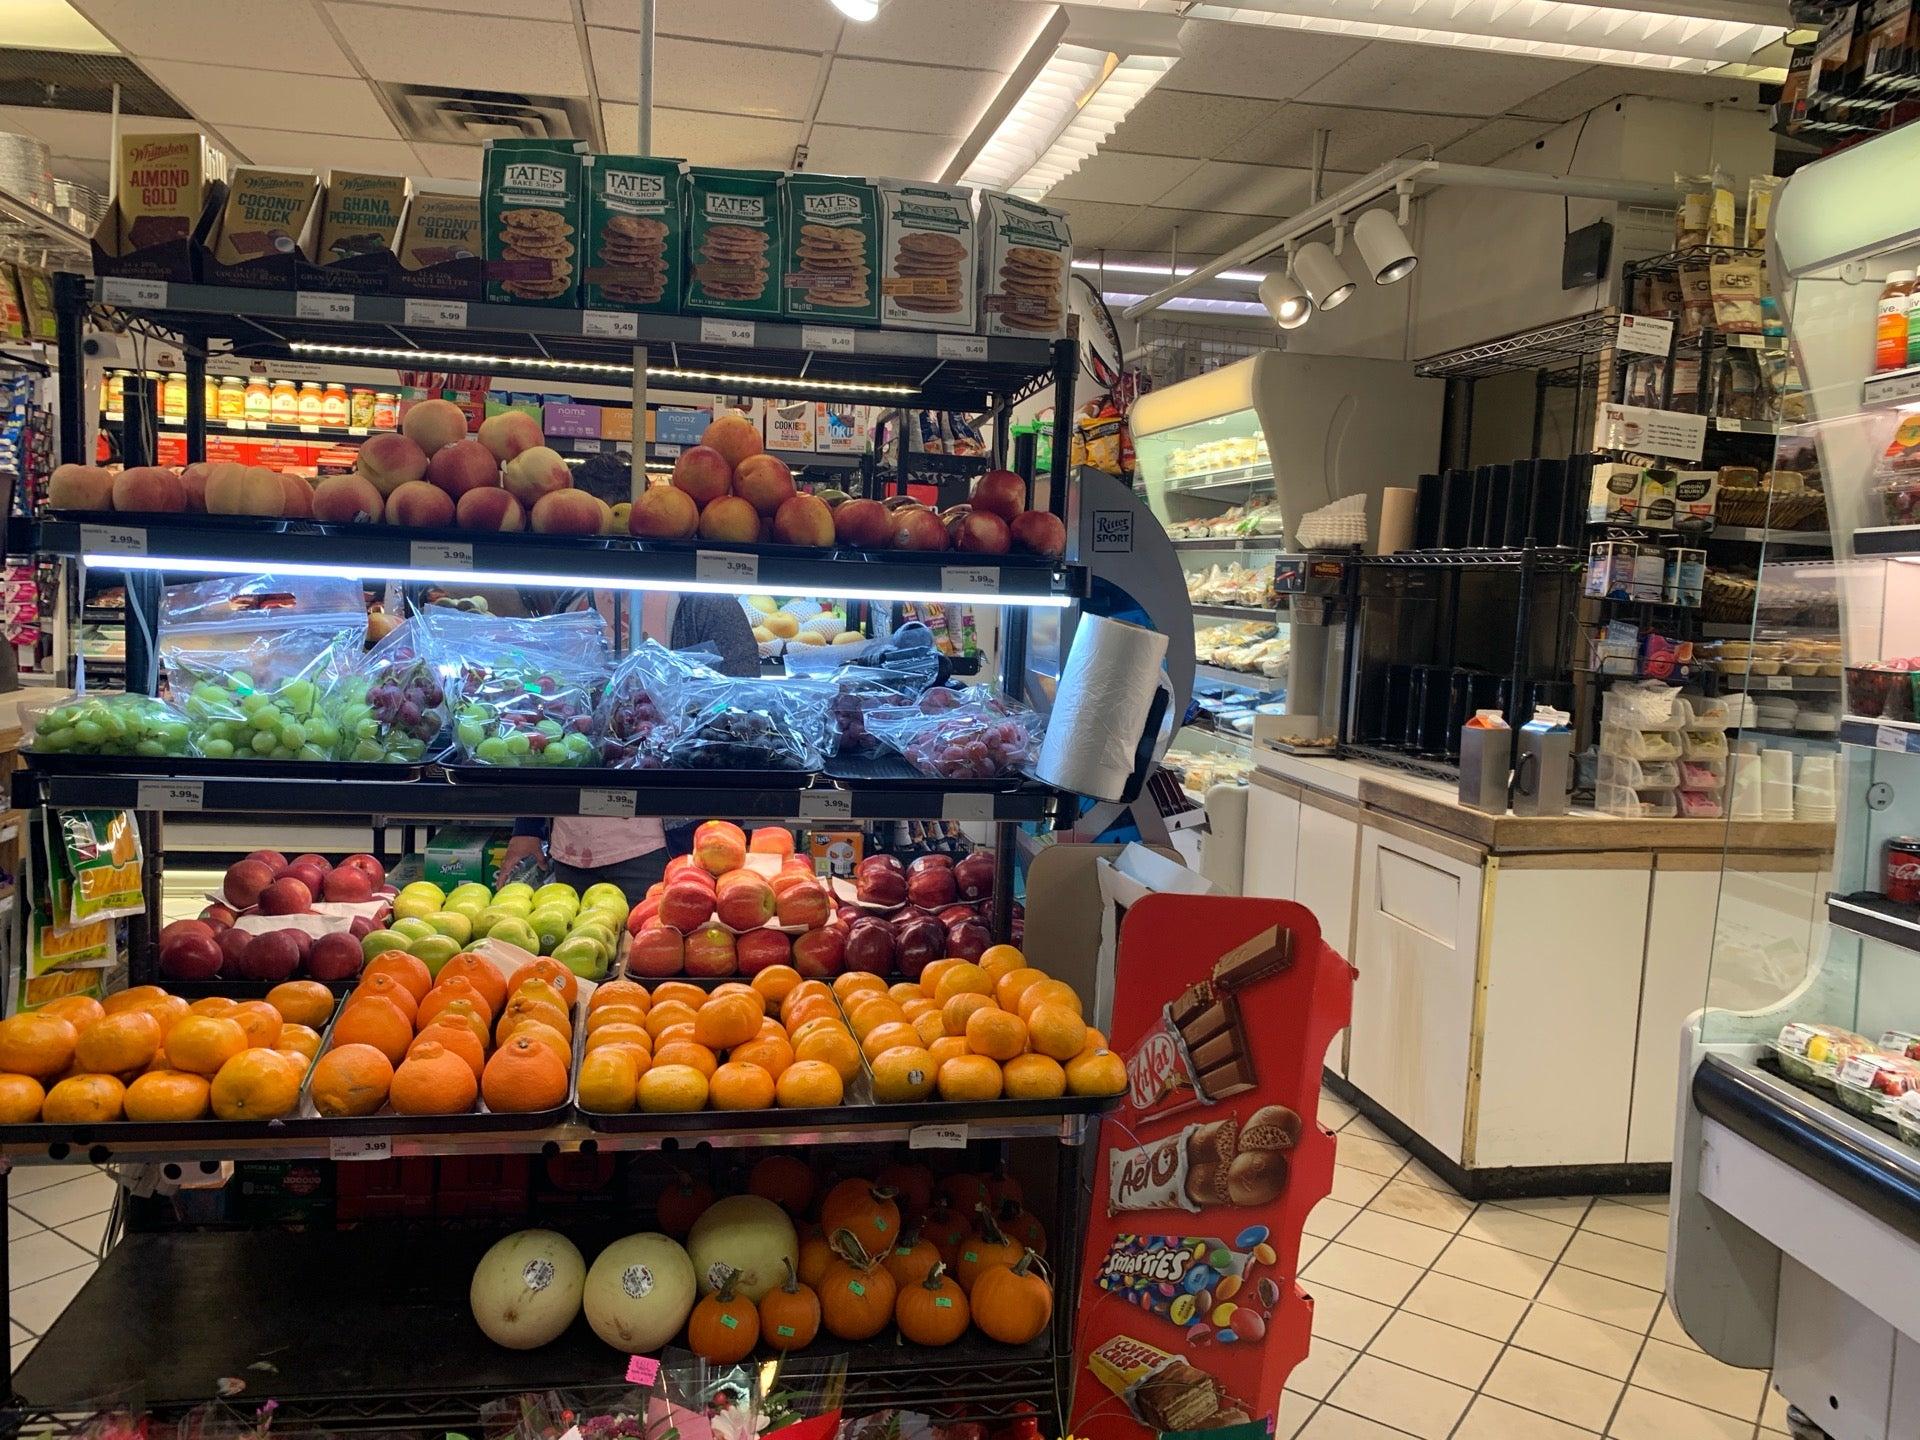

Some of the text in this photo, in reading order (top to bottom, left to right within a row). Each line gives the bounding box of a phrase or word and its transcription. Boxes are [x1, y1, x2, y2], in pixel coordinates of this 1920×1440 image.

[130, 169, 189, 188] ALMOND
[508, 166, 563, 184] TATE'S
[608, 173, 662, 192] TATE'S
[142, 188, 177, 206] GOLD
[613, 188, 635, 197] BAKE
[238, 193, 304, 212] COCONUT
[343, 197, 390, 213] GHANA
[709, 196, 761, 213] TATE'S
[807, 195, 858, 208] TATE'S
[245, 207, 291, 225] BLOCK
[417, 216, 480, 230] COCONUT
[424, 227, 469, 242] BLOCK
[138, 291, 159, 300] 5.99
[330, 305, 350, 313] 5.99
[440, 312, 460, 320] 5.99
[614, 323, 633, 331] 9.49
[731, 331, 750, 339] 9.49
[965, 346, 984, 354] 9.49
[558, 407, 586, 416] nomz
[1606, 410, 1624, 421] TEA
[668, 415, 696, 424] nomz
[1097, 517, 1129, 533] Ritter
[110, 535, 133, 544] 2.99
[1096, 534, 1129, 542] SPORT
[444, 551, 465, 559] 3.99
[727, 562, 747, 570] 3.99
[969, 575, 988, 583] 3.99
[170, 790, 192, 798] 3.99
[440, 862, 463, 873] Sprite
[1132, 1040, 1170, 1105] KitKat
[1102, 1349, 1141, 1370] CRISP
[1115, 1340, 1168, 1368] COFFEE
